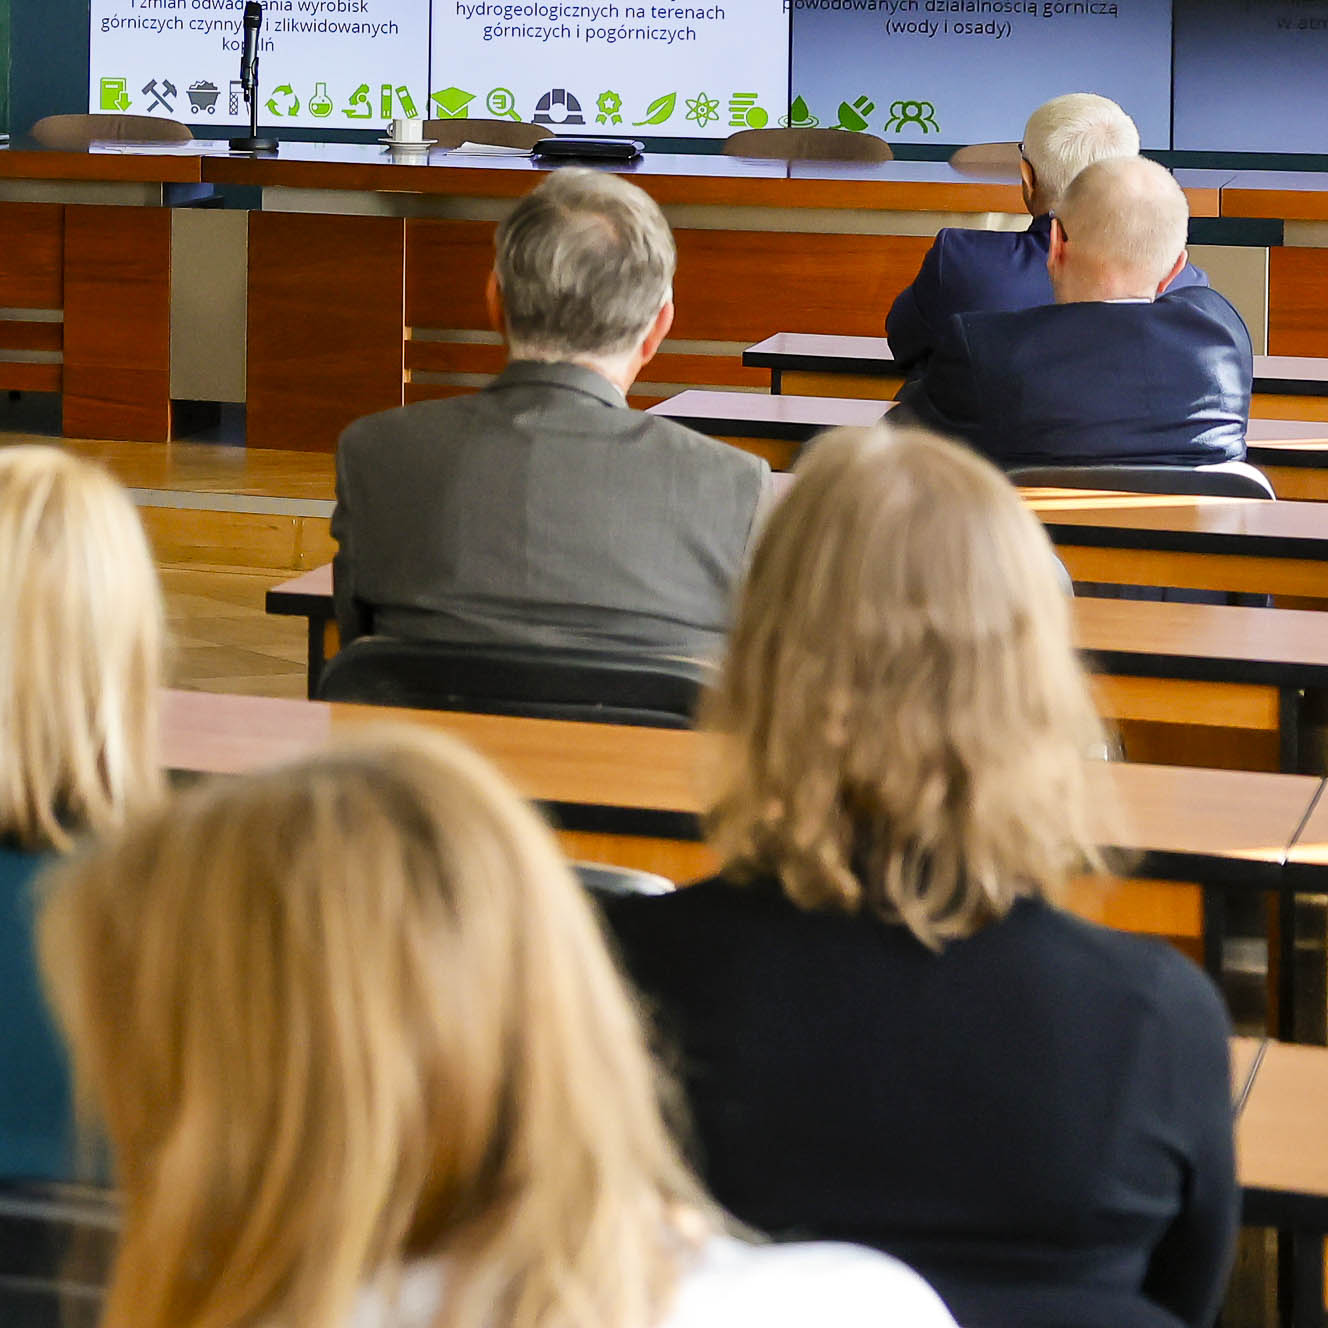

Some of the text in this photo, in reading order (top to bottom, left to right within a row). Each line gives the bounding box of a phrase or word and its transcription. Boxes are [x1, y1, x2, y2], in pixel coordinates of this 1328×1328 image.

[456, 1, 725, 22] hydrogeologicznych na terenach
[101, 13, 399, 36] górniczych zlikwidowanych
[482, 21, 696, 45] górniczych pogórniczych
[885, 18, 1012, 39] (wody osady)
